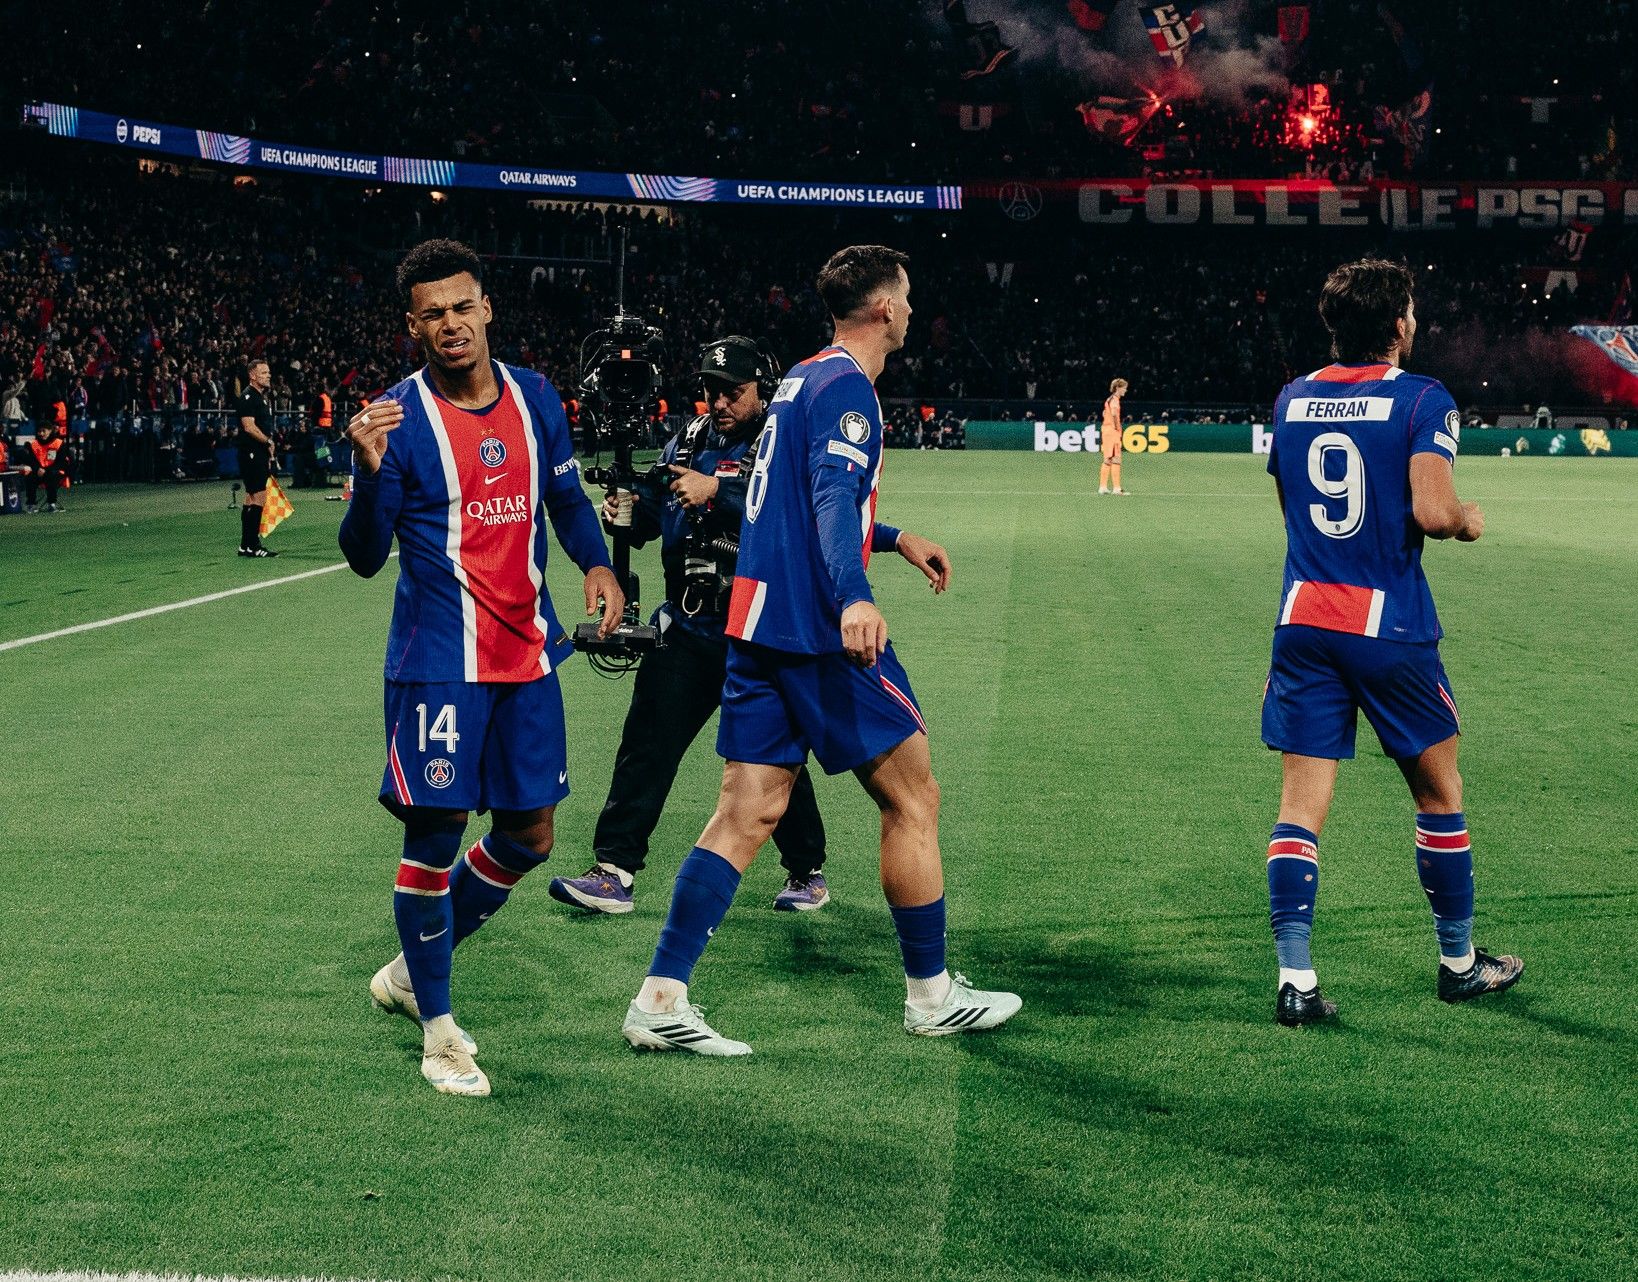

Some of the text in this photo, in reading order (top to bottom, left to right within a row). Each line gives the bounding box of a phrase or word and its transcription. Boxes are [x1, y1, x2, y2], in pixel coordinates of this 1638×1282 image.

[133, 125, 160, 145] PEPSI
[261, 147, 377, 175] UEFA CHAMPIONS LEAGUE
[499, 170, 577, 188] QATAR AIRWAYS
[737, 184, 925, 205] UEFA CHAMPIONS LEAGUE
[1079, 184, 1389, 228] COLLE
[1476, 188, 1605, 229] PSG
[1305, 401, 1369, 418] FERRAN
[1034, 422, 1170, 454] bet65
[746, 414, 777, 524] 8
[1307, 432, 1366, 539] 9
[466, 494, 528, 521] QATAR
[483, 511, 528, 526] AIRWAYS
[416, 703, 460, 753] 14
